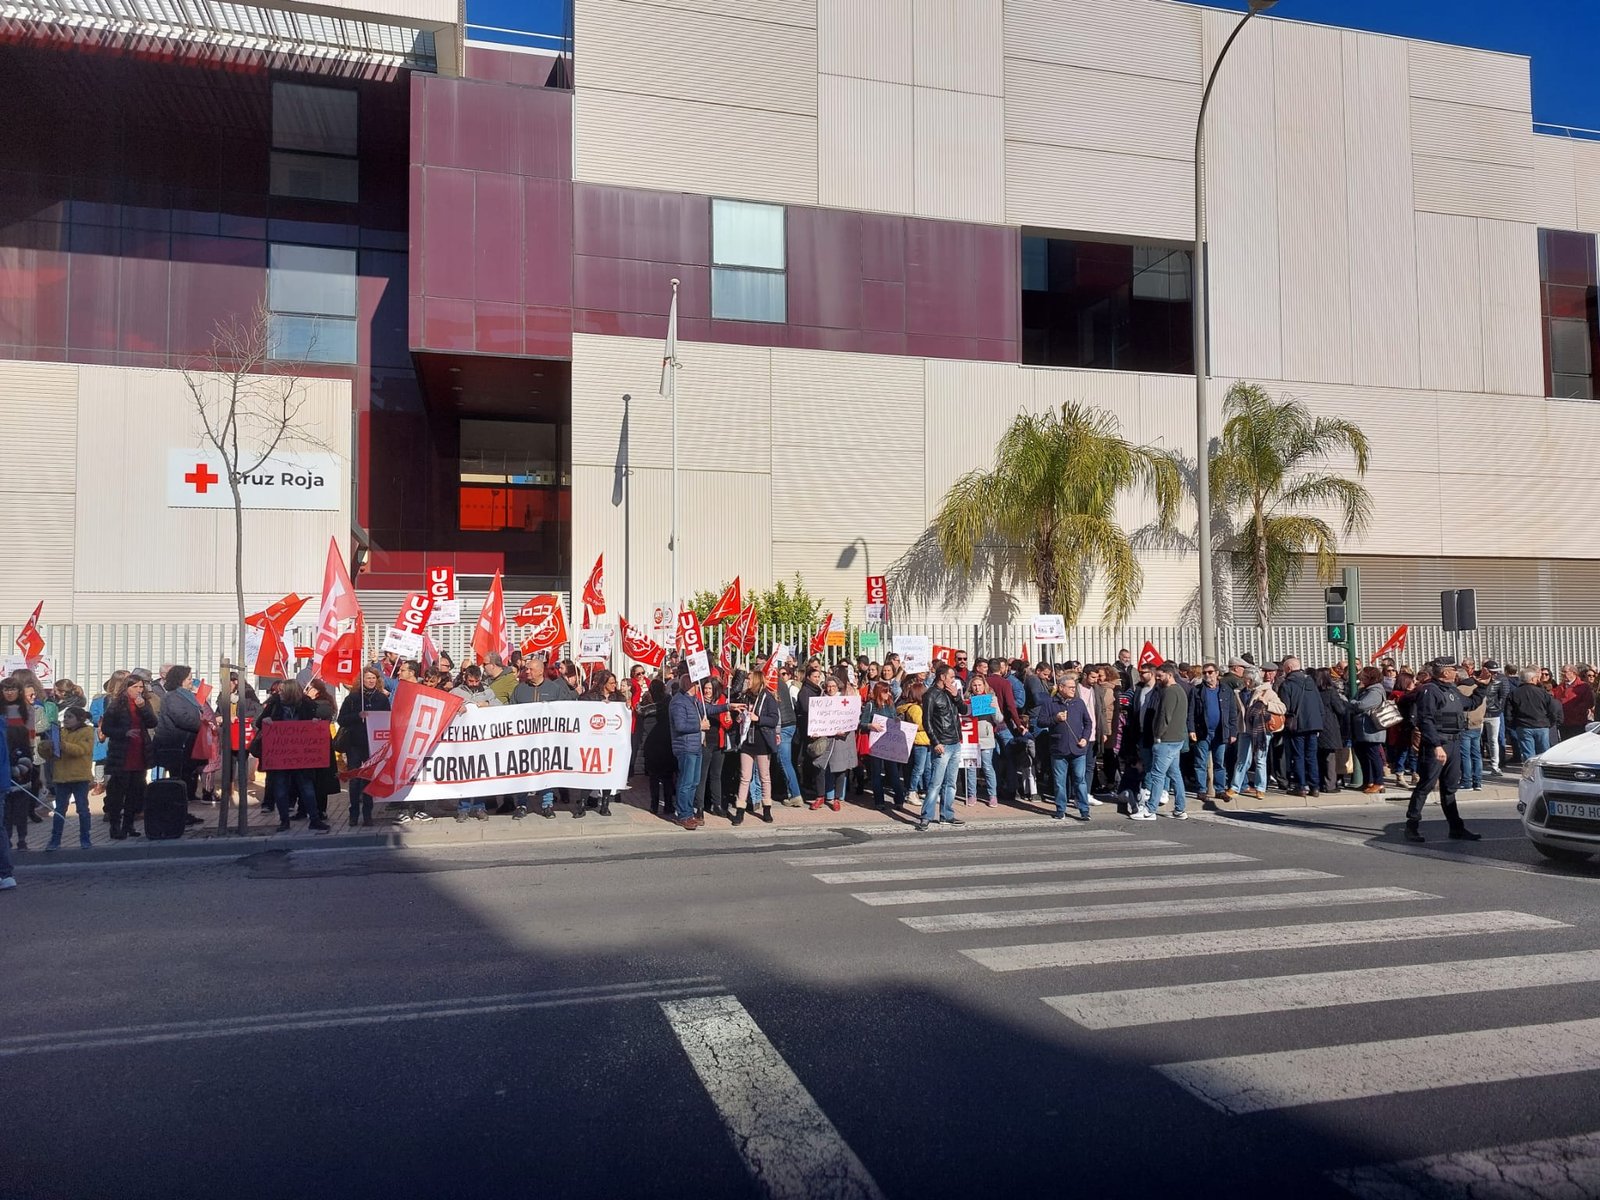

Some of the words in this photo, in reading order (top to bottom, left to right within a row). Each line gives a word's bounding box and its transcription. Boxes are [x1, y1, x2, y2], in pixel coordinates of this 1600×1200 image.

[281, 471, 324, 489] Roja
[680, 614, 700, 656] UGT
[462, 724, 487, 742] HAY
[490, 720, 514, 739] QUE
[516, 716, 581, 735] CUMPLIRLA
[411, 753, 490, 782] FORMA
[494, 745, 574, 777] LABORAL
[579, 746, 602, 772] YA
[1557, 803, 1585, 817] 0179
